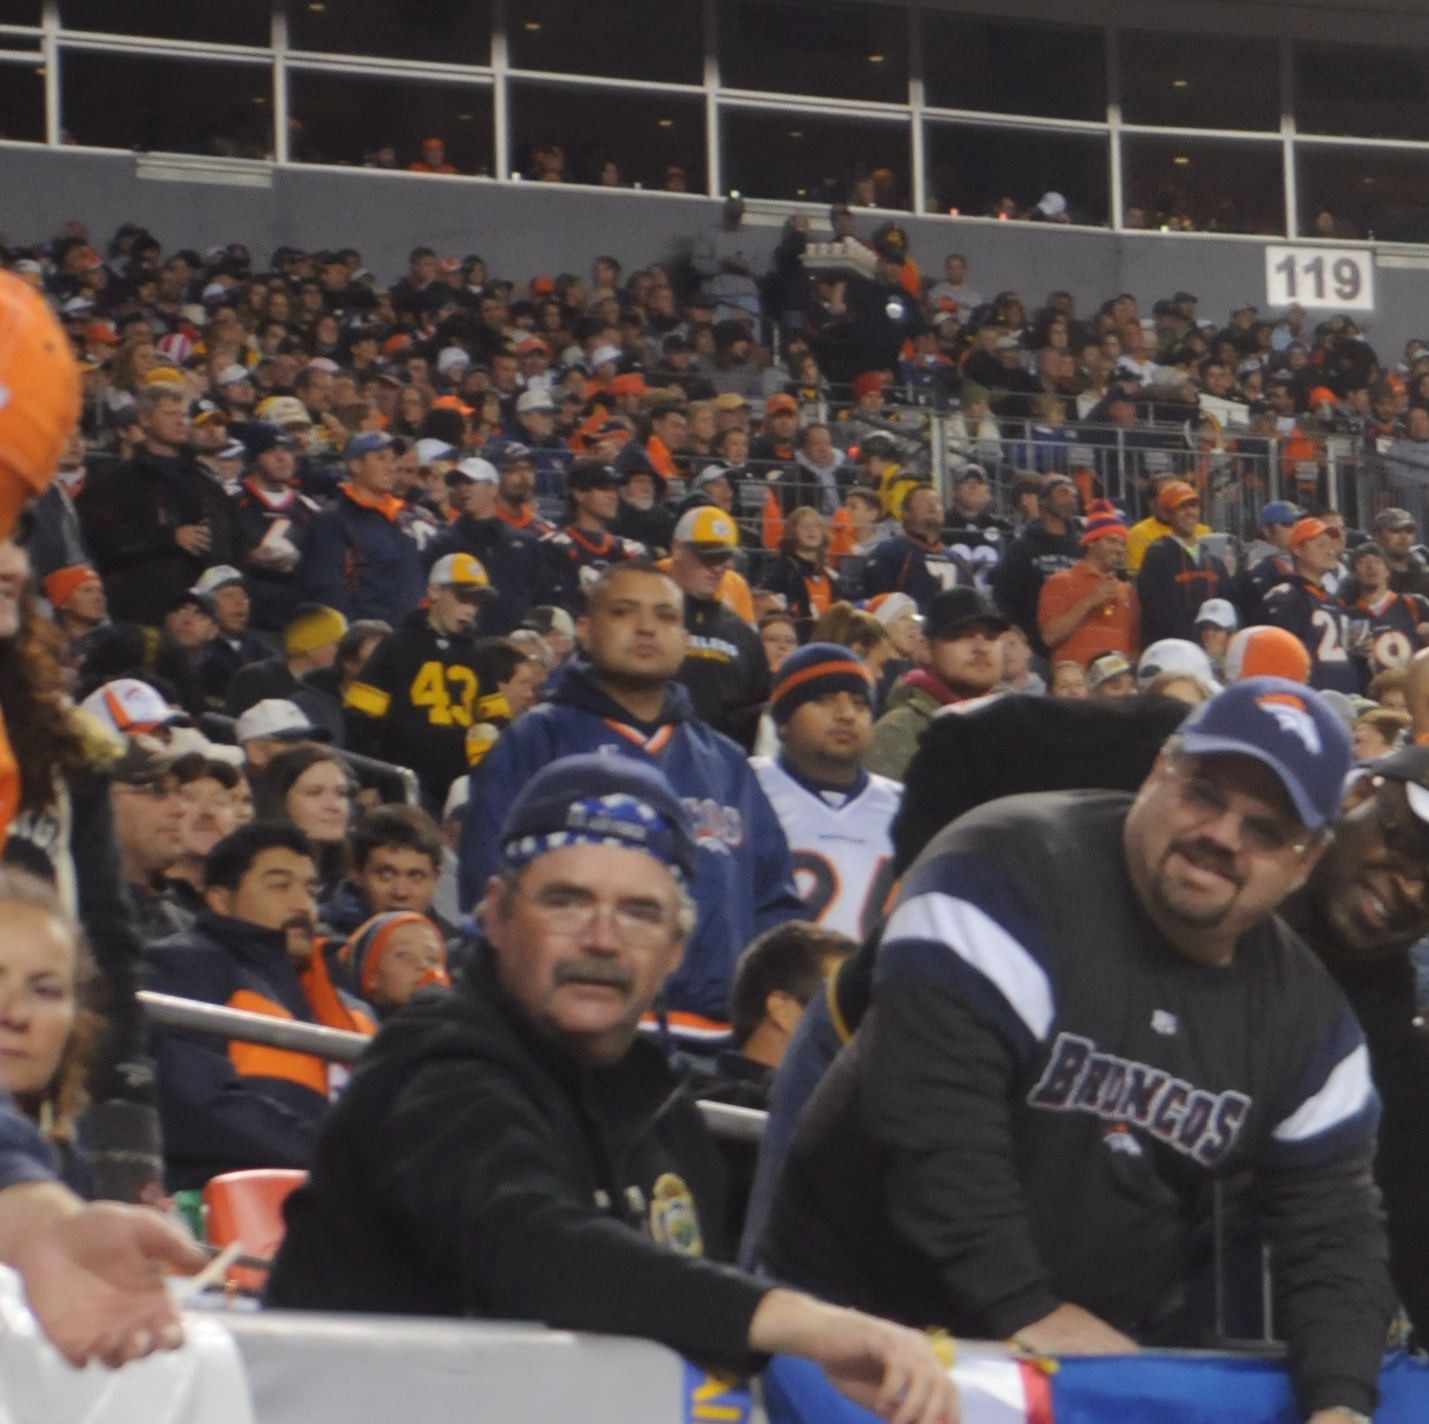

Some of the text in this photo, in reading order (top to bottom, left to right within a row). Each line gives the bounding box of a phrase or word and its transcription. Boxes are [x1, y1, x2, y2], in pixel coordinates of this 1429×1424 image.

[1276, 254, 1361, 301] 119
[410, 660, 478, 728] 43
[1027, 1031, 1252, 1168] BRONCOS
